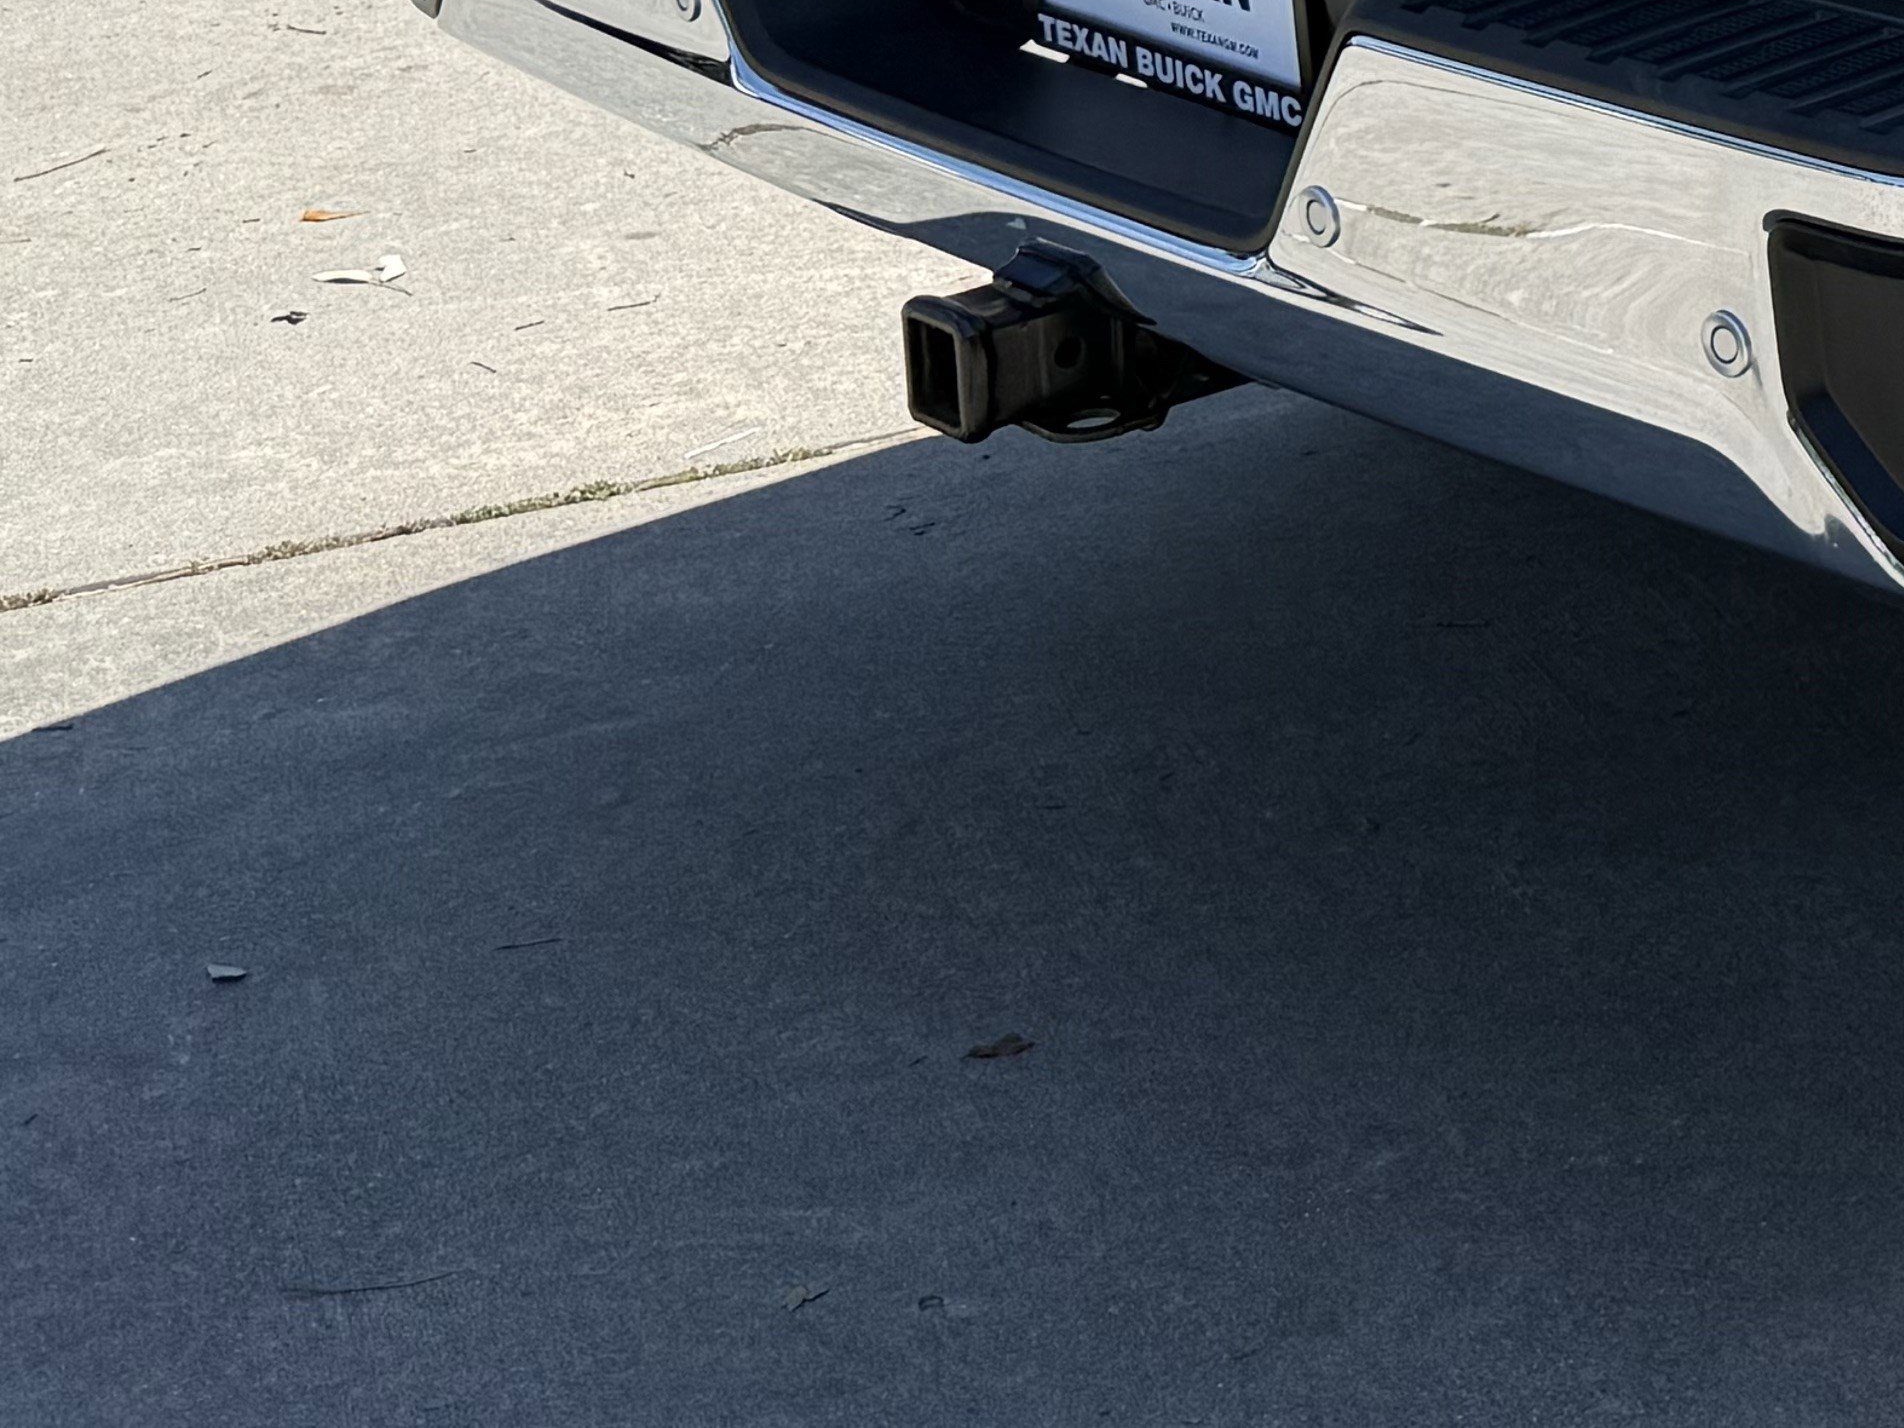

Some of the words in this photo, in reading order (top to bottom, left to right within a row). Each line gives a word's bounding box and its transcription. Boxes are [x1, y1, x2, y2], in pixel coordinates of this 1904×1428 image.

[1037, 12, 1129, 70] TEXAN
[1135, 46, 1226, 104] BUICK
[1232, 81, 1303, 129] GMC
